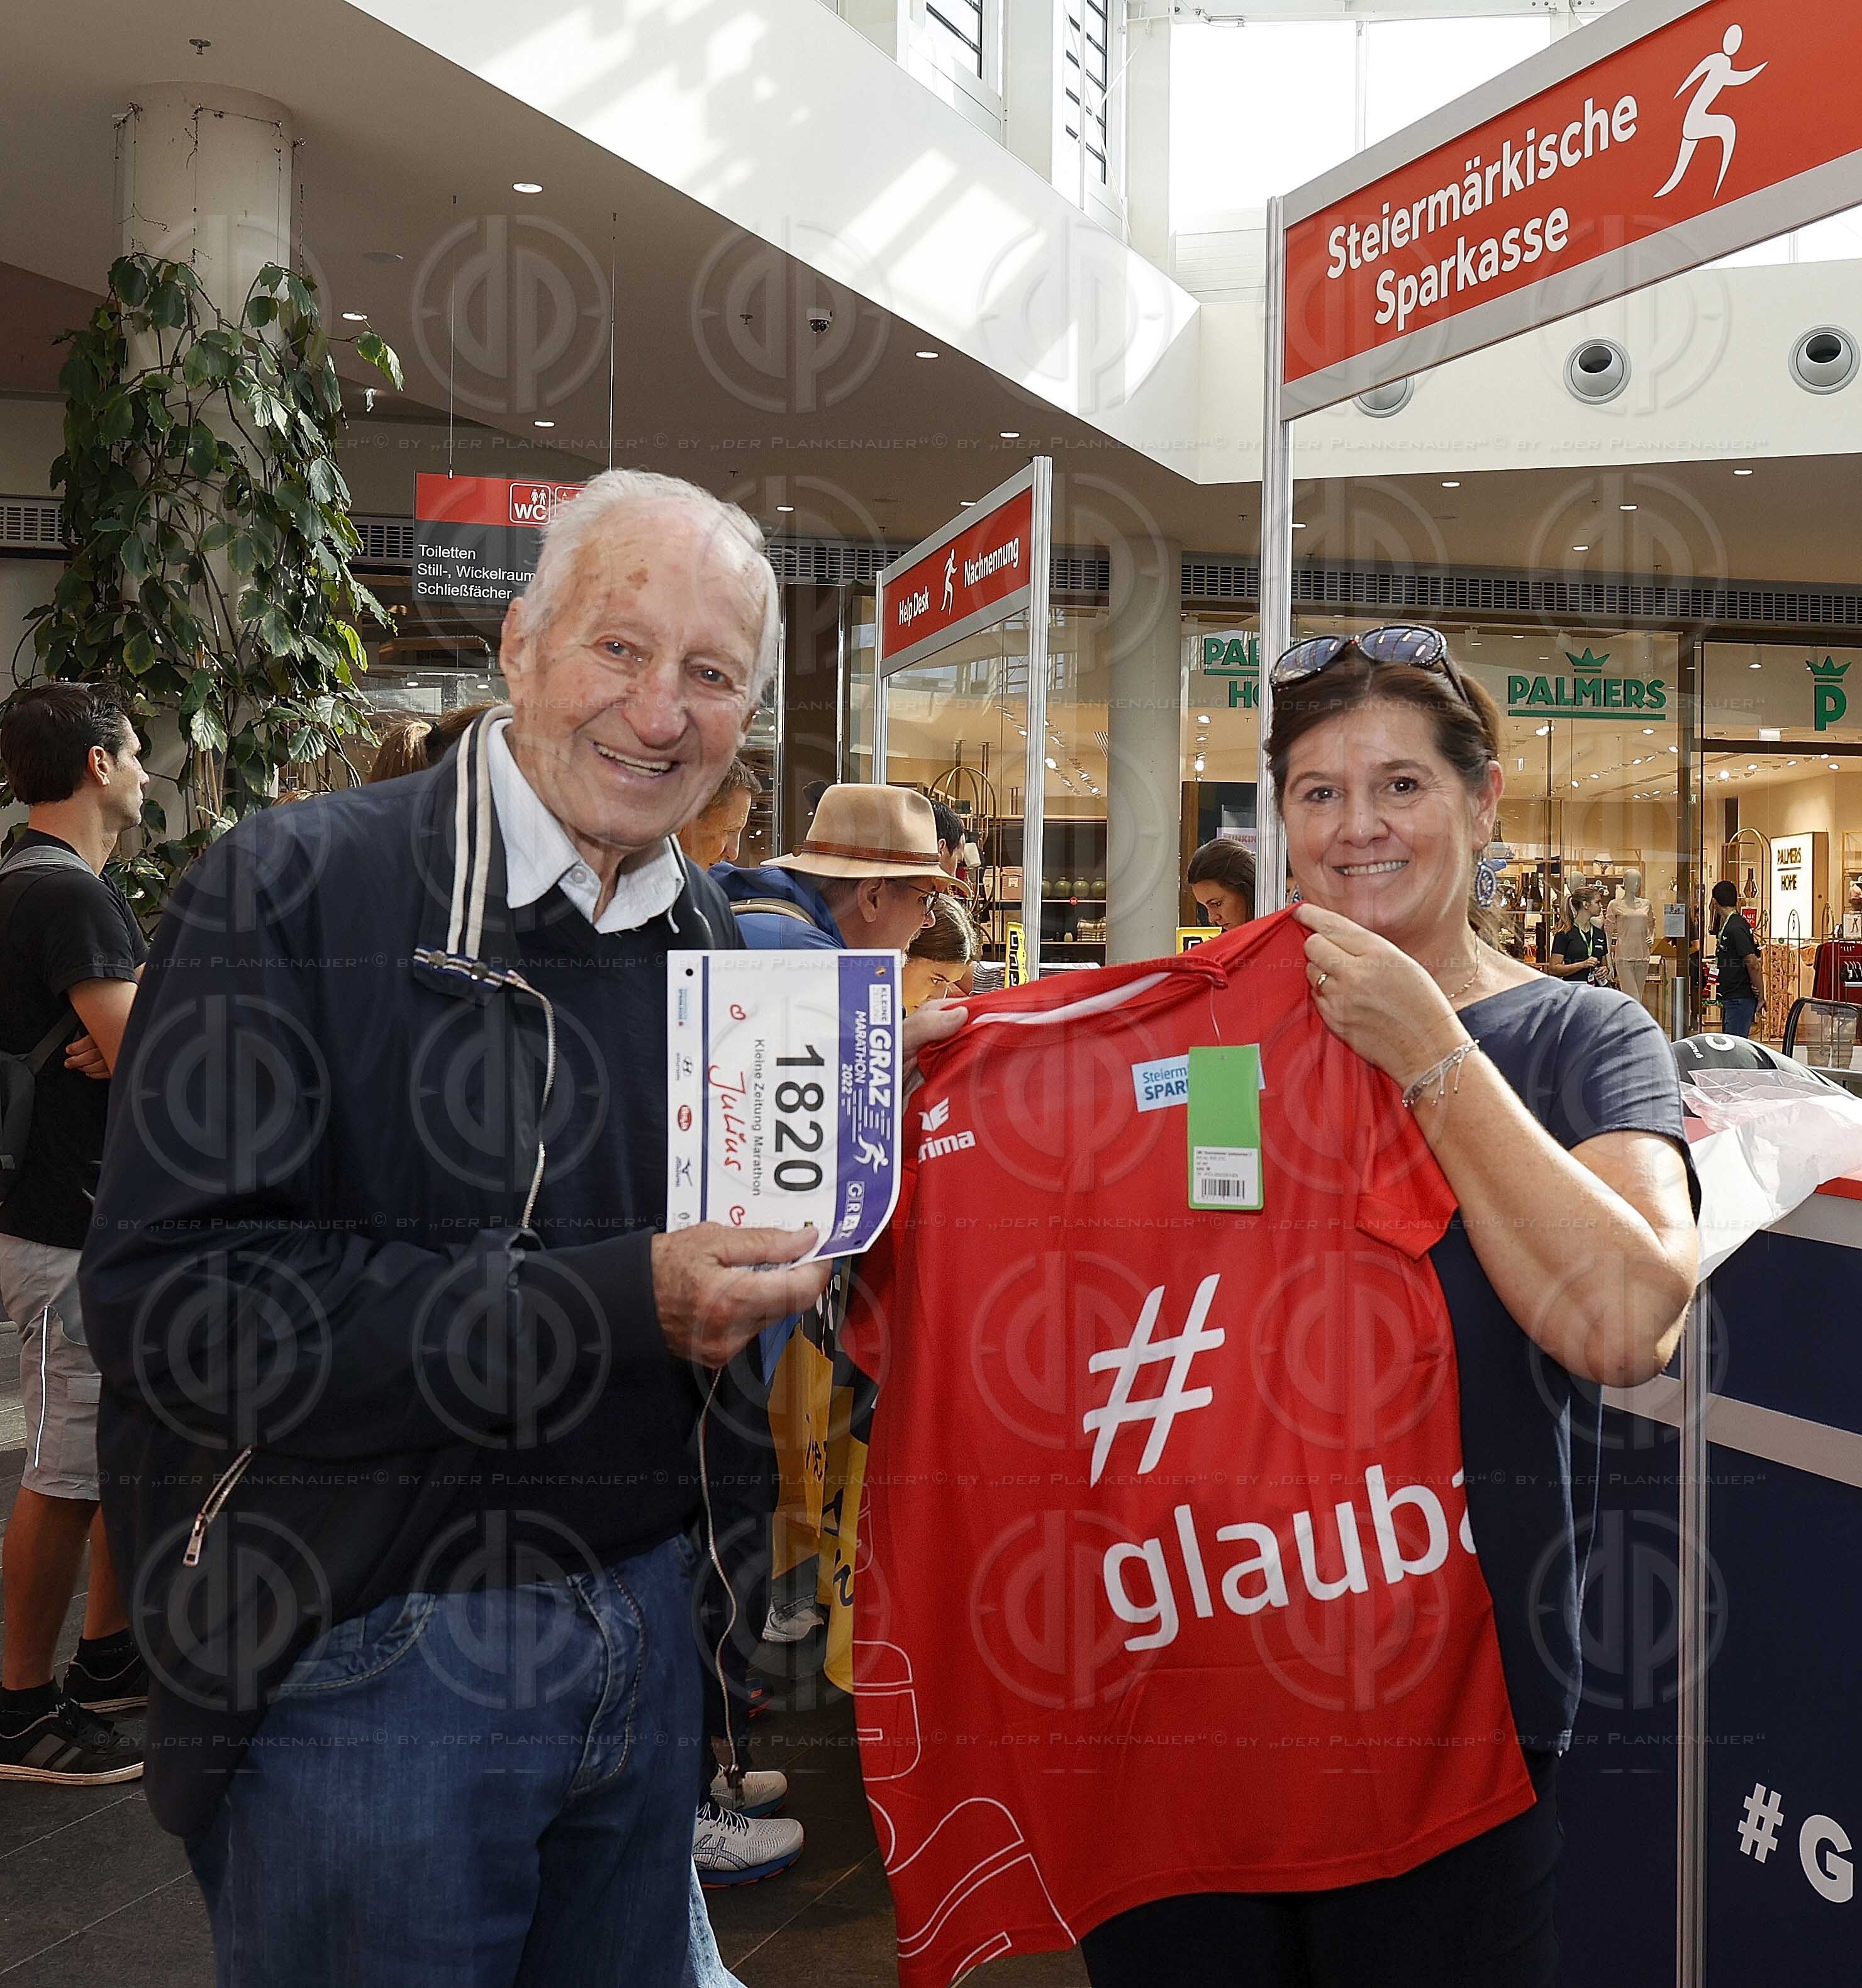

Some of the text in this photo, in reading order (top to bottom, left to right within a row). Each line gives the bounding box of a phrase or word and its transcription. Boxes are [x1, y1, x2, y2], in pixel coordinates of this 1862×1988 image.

[1326, 93, 1638, 281] Steiermärkische
[1374, 206, 1570, 332] Sparkasse
[513, 503, 546, 521] WC
[418, 544, 476, 560] Toiletten
[417, 581, 513, 600] Schließfächer
[418, 563, 535, 583] Still-, Wickelraum
[898, 536, 1019, 628] Help Desk Nachnennung
[1508, 675, 1667, 710] PALMERS
[1814, 685, 1848, 731] P
[1777, 847, 1802, 865] PALMERS
[1781, 874, 1797, 891] HOME
[854, 1010, 867, 1084] MARATHON
[840, 1063, 853, 1095] 2022
[868, 1028, 892, 1108] GRAZ
[1142, 1064, 1188, 1084] Steierm
[708, 1064, 747, 1172] Julius
[750, 1039, 765, 1197] Kleine Zeitung Marathon
[774, 1044, 825, 1192] 1820
